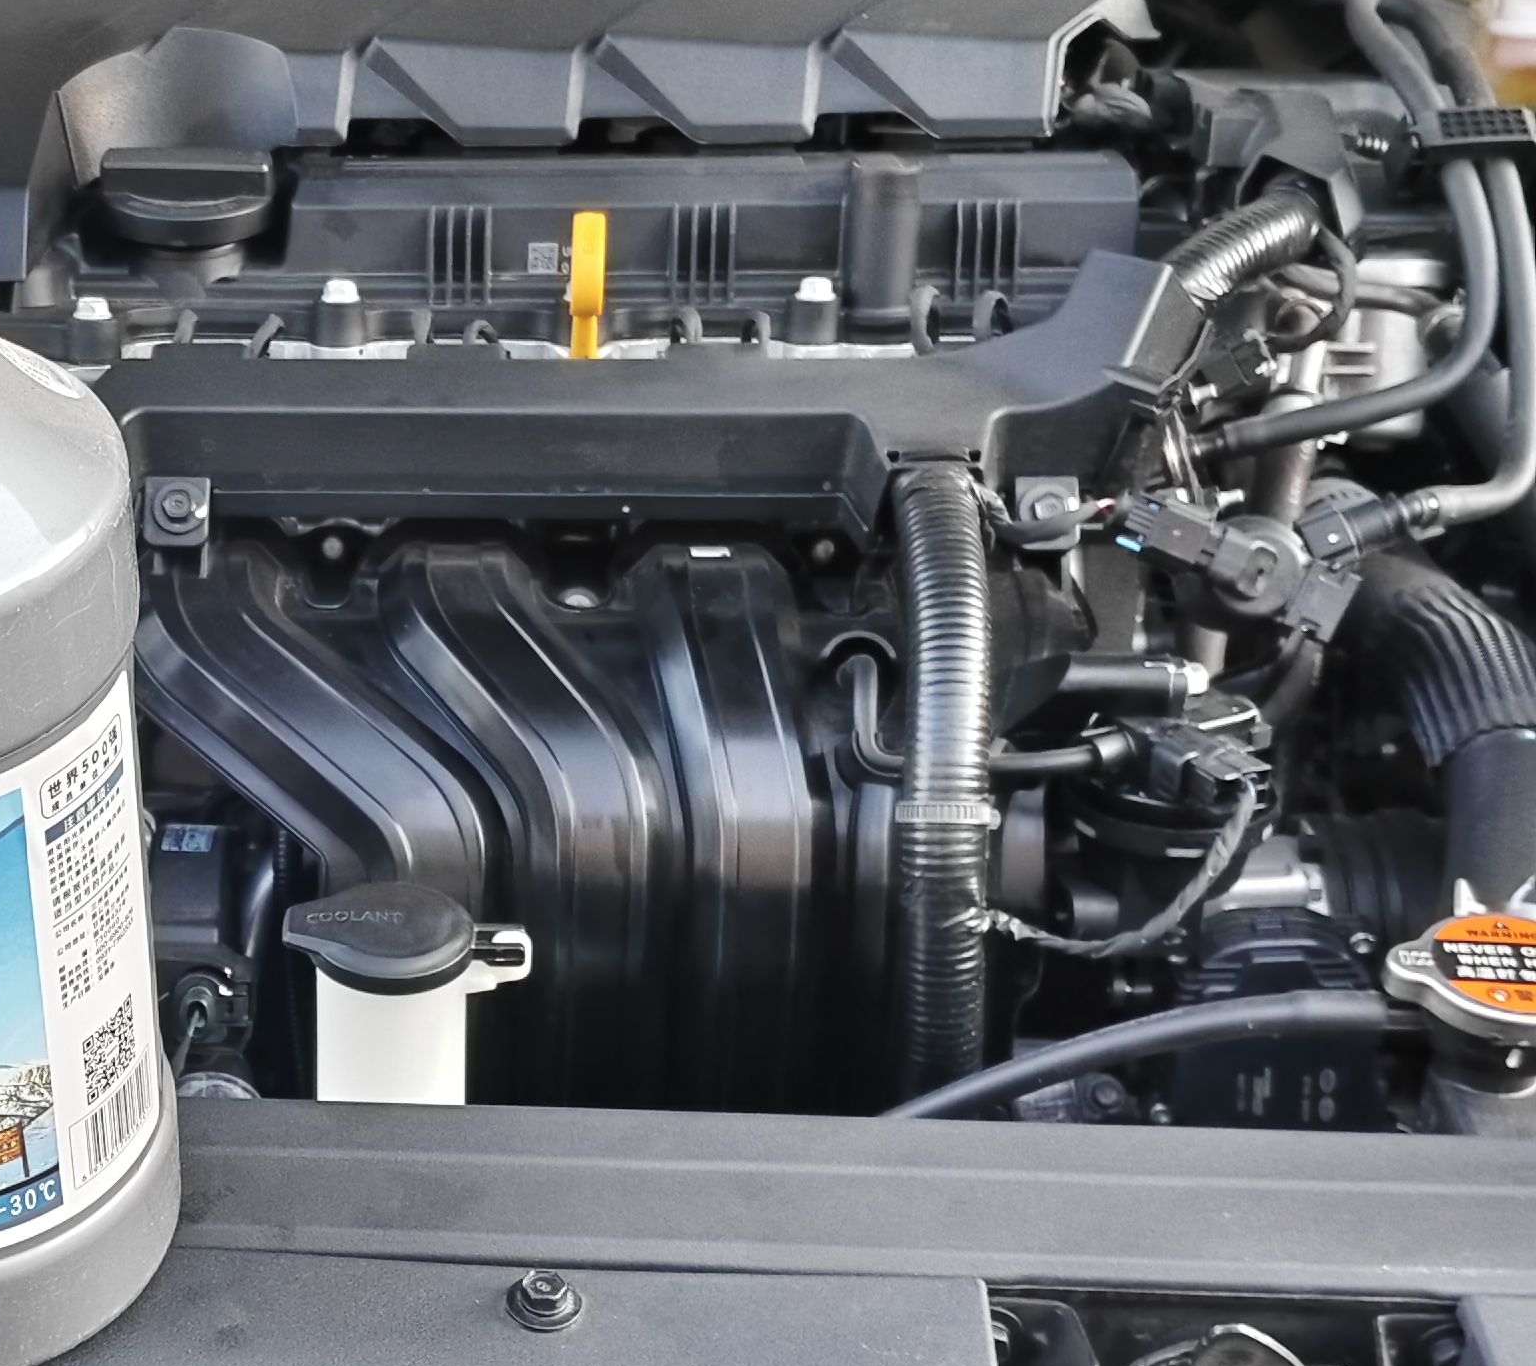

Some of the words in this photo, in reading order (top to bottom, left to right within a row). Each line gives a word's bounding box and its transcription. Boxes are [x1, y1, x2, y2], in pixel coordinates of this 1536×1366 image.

[306, 910, 404, 924] COOLANT
[1442, 942, 1514, 956] NEVER
[1456, 954, 1518, 968] WHEN
